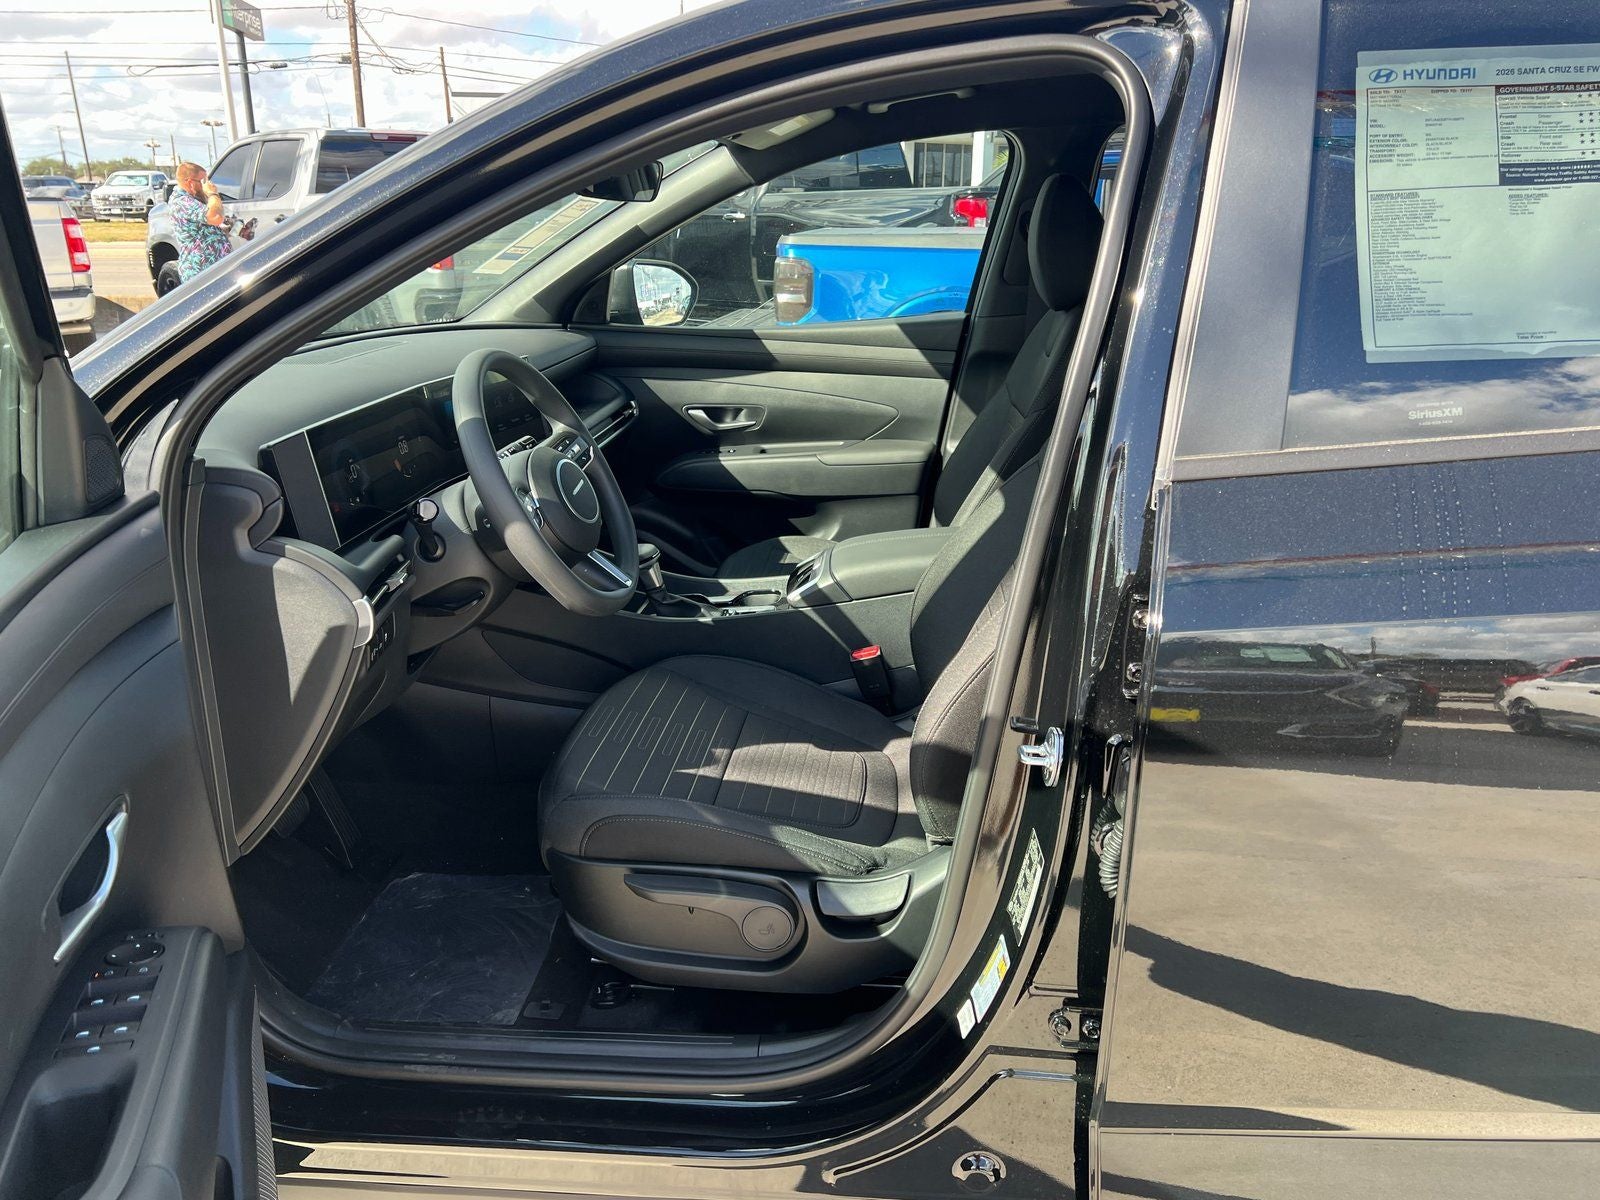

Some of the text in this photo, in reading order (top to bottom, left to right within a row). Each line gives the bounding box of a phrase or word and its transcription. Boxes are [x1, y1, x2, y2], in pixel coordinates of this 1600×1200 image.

[1403, 67, 1476, 80] HYUNDAI
[1496, 68, 1515, 76] 2026
[1517, 67, 1547, 75] SANTA
[1548, 66, 1572, 75] CRUZ
[1408, 407, 1464, 420] SiriusXM
